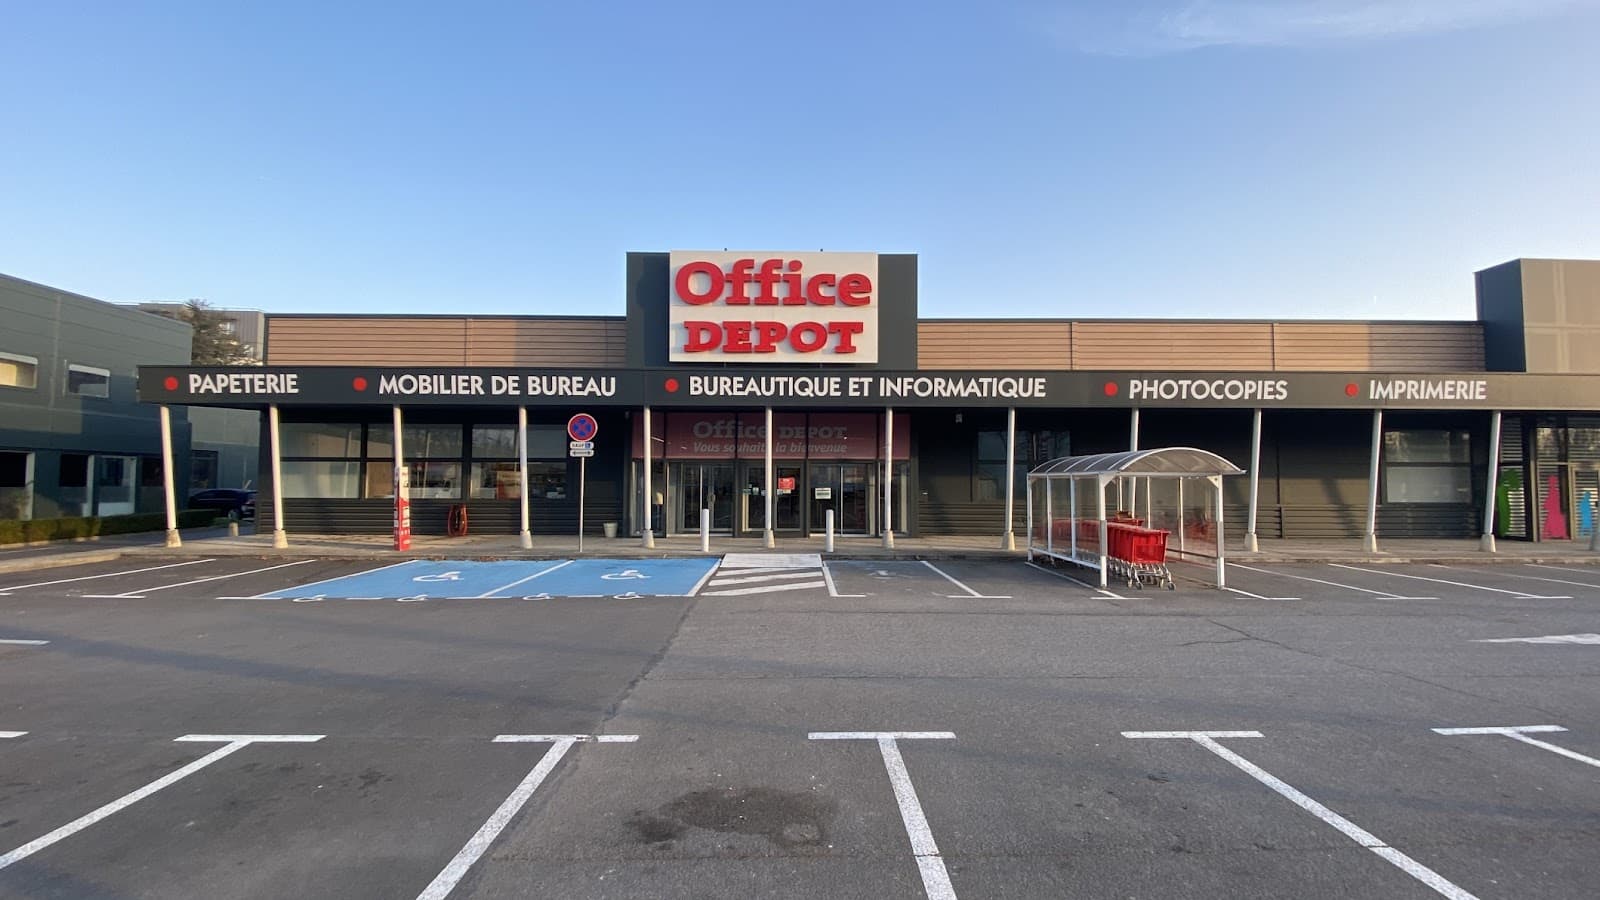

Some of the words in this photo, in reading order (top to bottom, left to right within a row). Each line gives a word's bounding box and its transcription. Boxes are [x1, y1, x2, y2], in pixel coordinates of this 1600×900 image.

[675, 259, 872, 306] Office
[683, 321, 864, 353] DEPOT
[188, 373, 299, 394] PAPETERIE
[378, 374, 485, 395] MOBILIER
[491, 375, 521, 395] DE
[527, 376, 617, 397] BUREAU
[689, 376, 841, 398] BUREAUTIQUE
[848, 377, 872, 397] ET
[879, 377, 1047, 399] INFORMATIQUE
[1128, 379, 1289, 401] PHOTOCOPIES
[1368, 379, 1488, 401] IMPRIMERIE
[693, 420, 767, 439] Office
[779, 426, 848, 439] DEPOT
[694, 442, 720, 453] Vous
[724, 441, 769, 453] souhait
[775, 441, 787, 453] la
[790, 441, 848, 453] bienvenue
